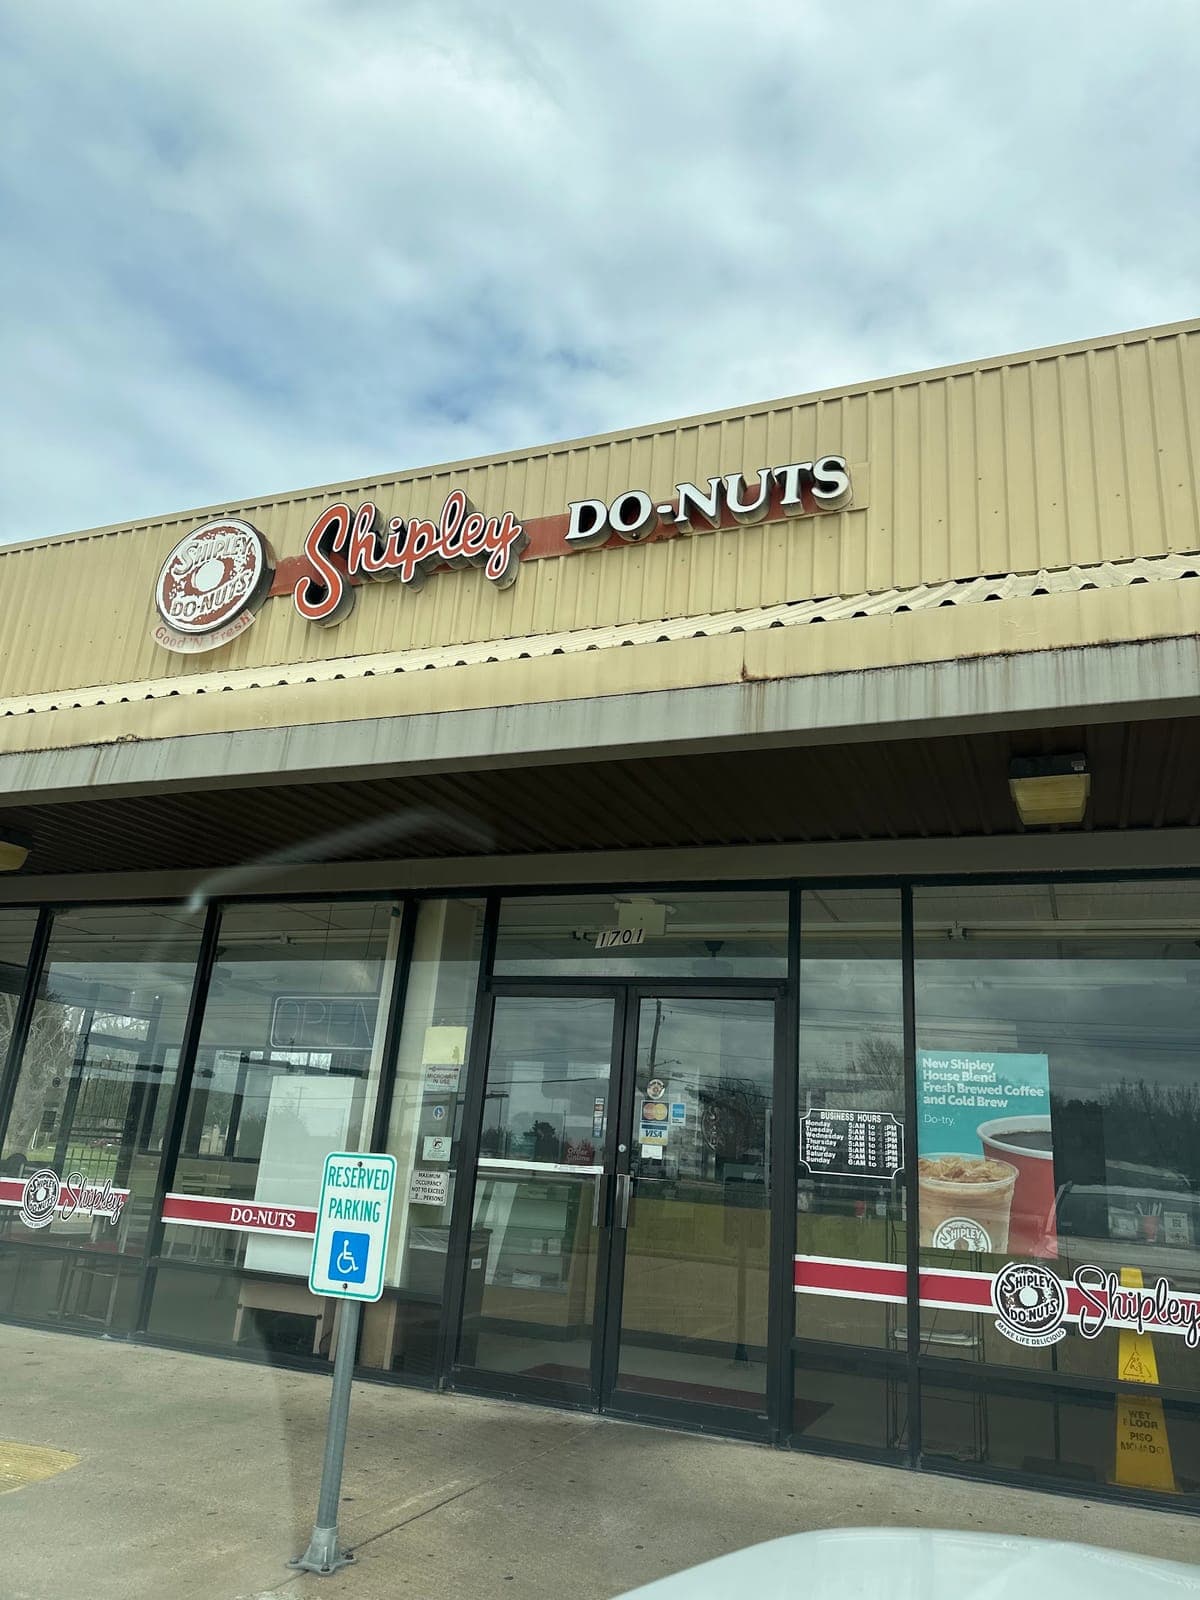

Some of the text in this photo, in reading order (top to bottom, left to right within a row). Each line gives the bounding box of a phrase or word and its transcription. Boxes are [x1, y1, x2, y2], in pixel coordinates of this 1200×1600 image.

[294, 454, 850, 619] Shipley DO-NUTS
[173, 536, 252, 575] SHIPLEY
[155, 626, 187, 649] Good
[210, 611, 250, 644] Fresh
[600, 928, 643, 947] 1701
[922, 1058, 994, 1072] New Shipley
[923, 1070, 996, 1083] House Blend
[923, 1082, 1044, 1097] Fresh Brewed Coffee
[923, 1095, 1008, 1107] and Cold Brew
[806, 1120, 831, 1128] Monday
[820, 1112, 881, 1123] BUSINESS HOURS
[924, 1113, 955, 1126] Do-try.
[645, 1129, 663, 1138] VISA
[806, 1126, 833, 1134] Tuesday
[806, 1132, 844, 1140] Wednesday
[806, 1138, 837, 1147] Thursday
[806, 1144, 826, 1152] Friday
[806, 1150, 836, 1159] Saturday
[806, 1156, 831, 1164] Sunday
[327, 1166, 389, 1190] RESERVED
[61, 1172, 125, 1225] Shipley
[328, 1197, 381, 1223] PARKING
[230, 1207, 296, 1227] DO-NUTS
[940, 1227, 981, 1244] SHIPLEY
[1003, 1265, 1200, 1347] SHIPLEY Shipley
[997, 1321, 1065, 1345] MAKE LIFE DELICIOUS
[1130, 1432, 1152, 1442] PISO
